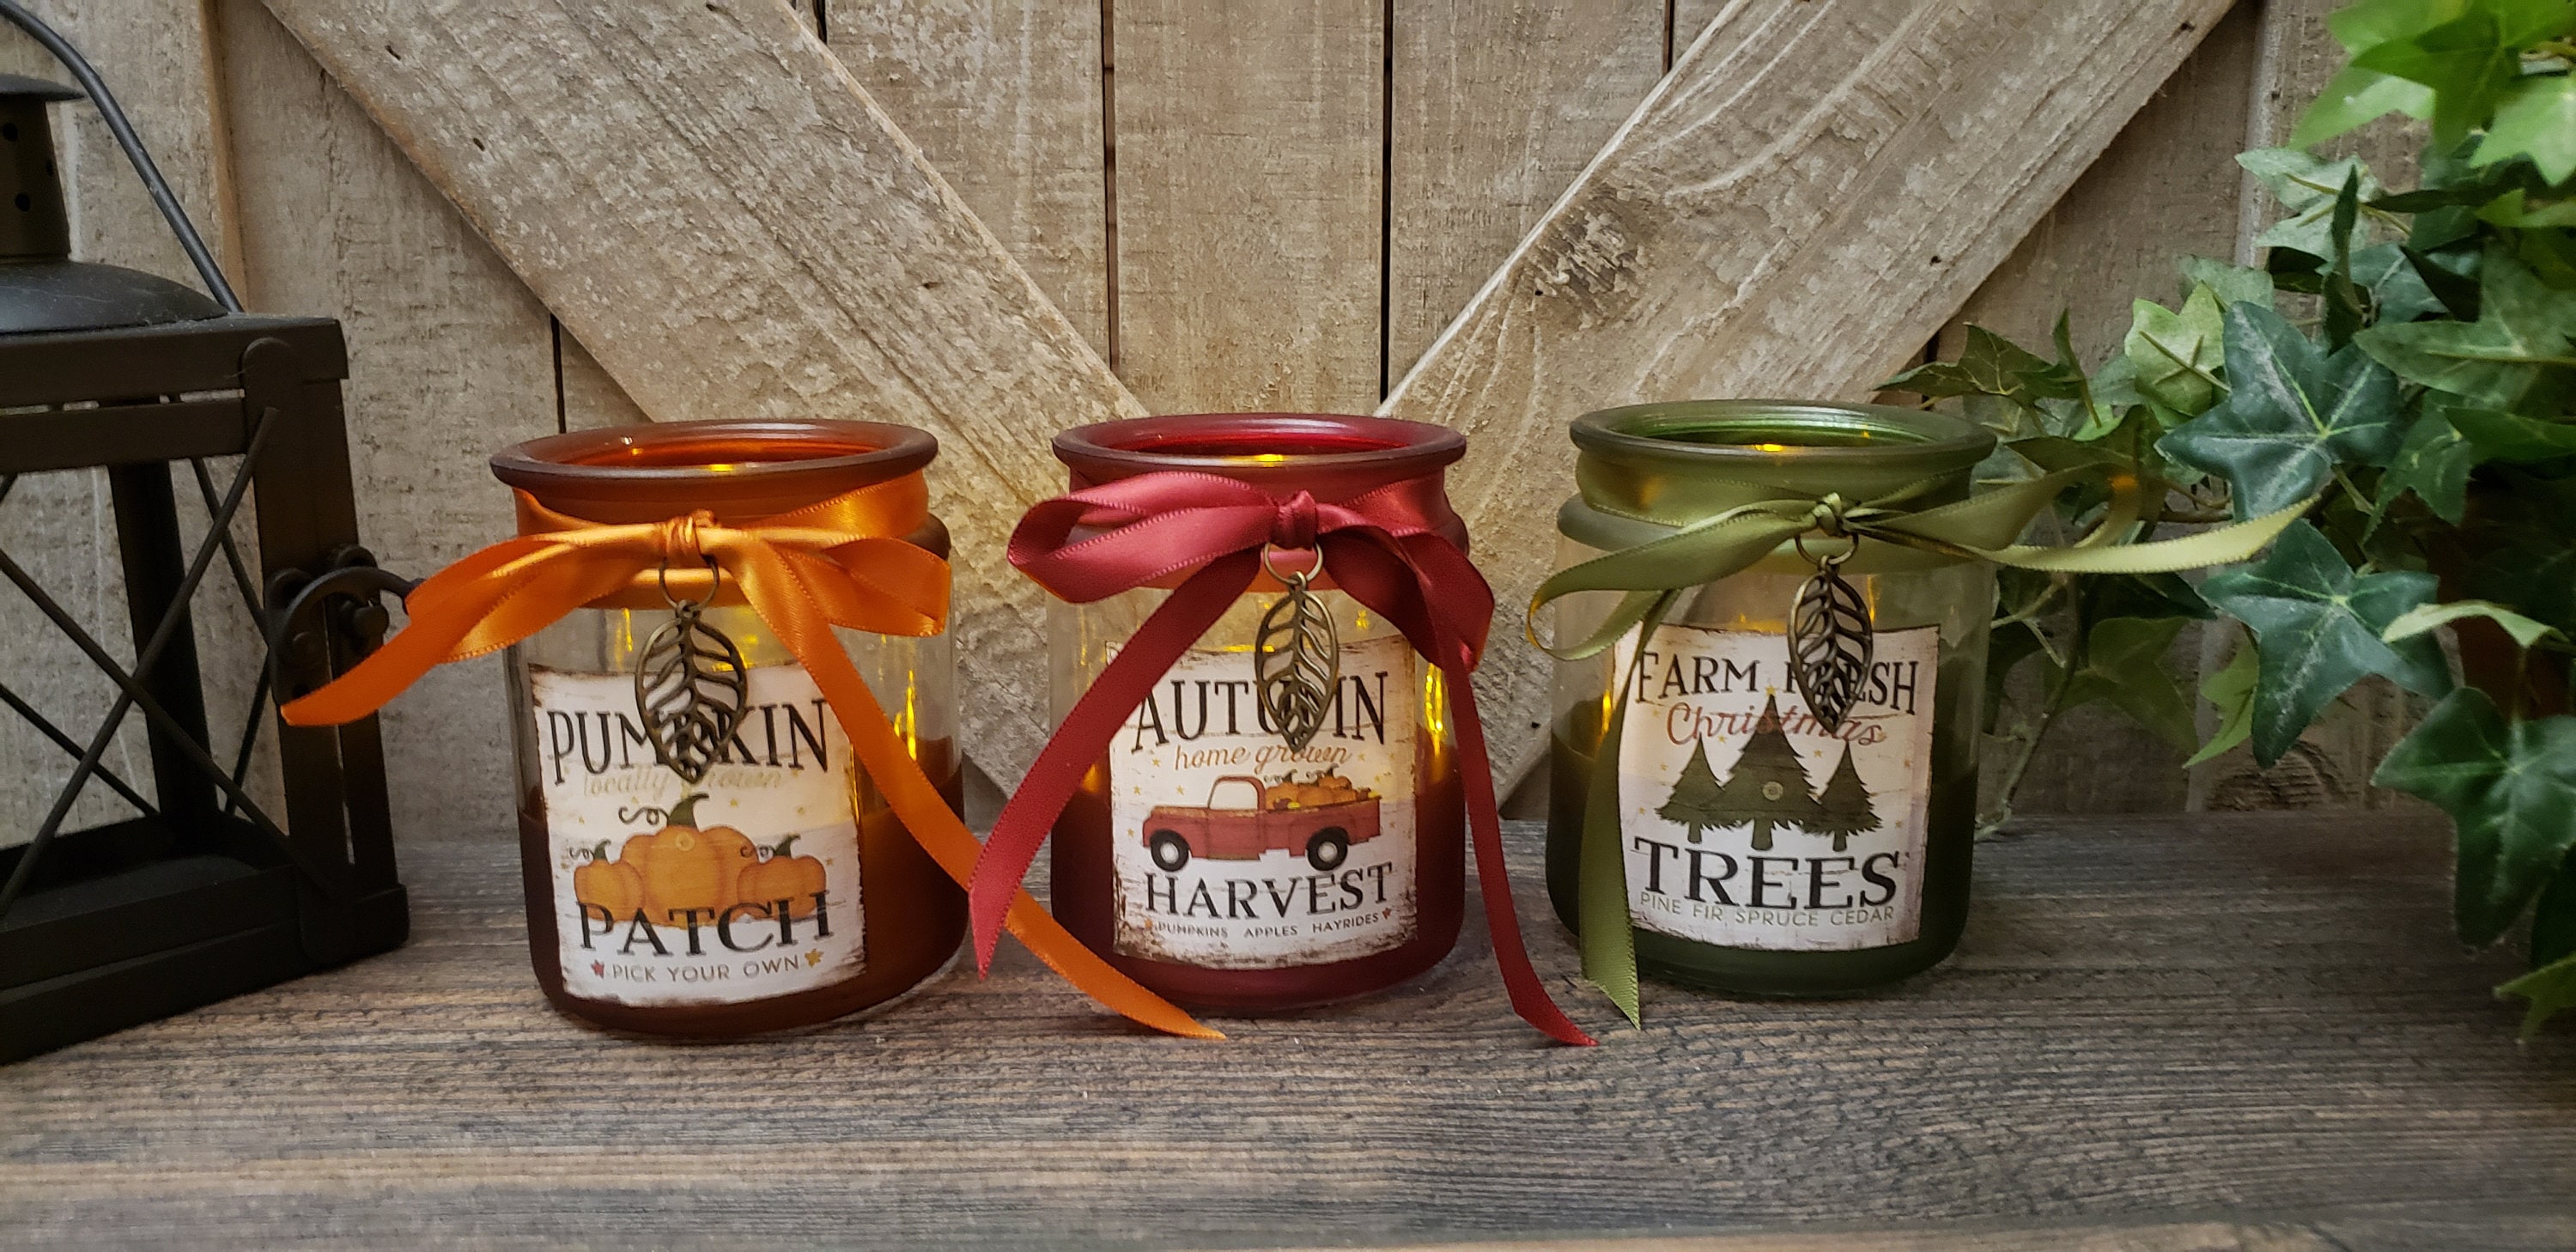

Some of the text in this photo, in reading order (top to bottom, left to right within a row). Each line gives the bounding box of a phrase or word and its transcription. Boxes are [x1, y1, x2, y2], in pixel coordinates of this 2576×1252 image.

[1635, 651, 1761, 704] FARM
[1666, 701, 1888, 747] Christmas
[1174, 745, 1250, 771] home
[1144, 860, 1394, 921] HARVEST
[1633, 836, 1903, 911] TREES
[574, 890, 835, 957] PATCH
[1157, 912, 1380, 939] PUMPKINS APPLES HAYRIDES
[1639, 890, 1895, 927] PINE FIR SPRUCE CEDAR
[611, 954, 800, 982] PICK YOUR OWN
